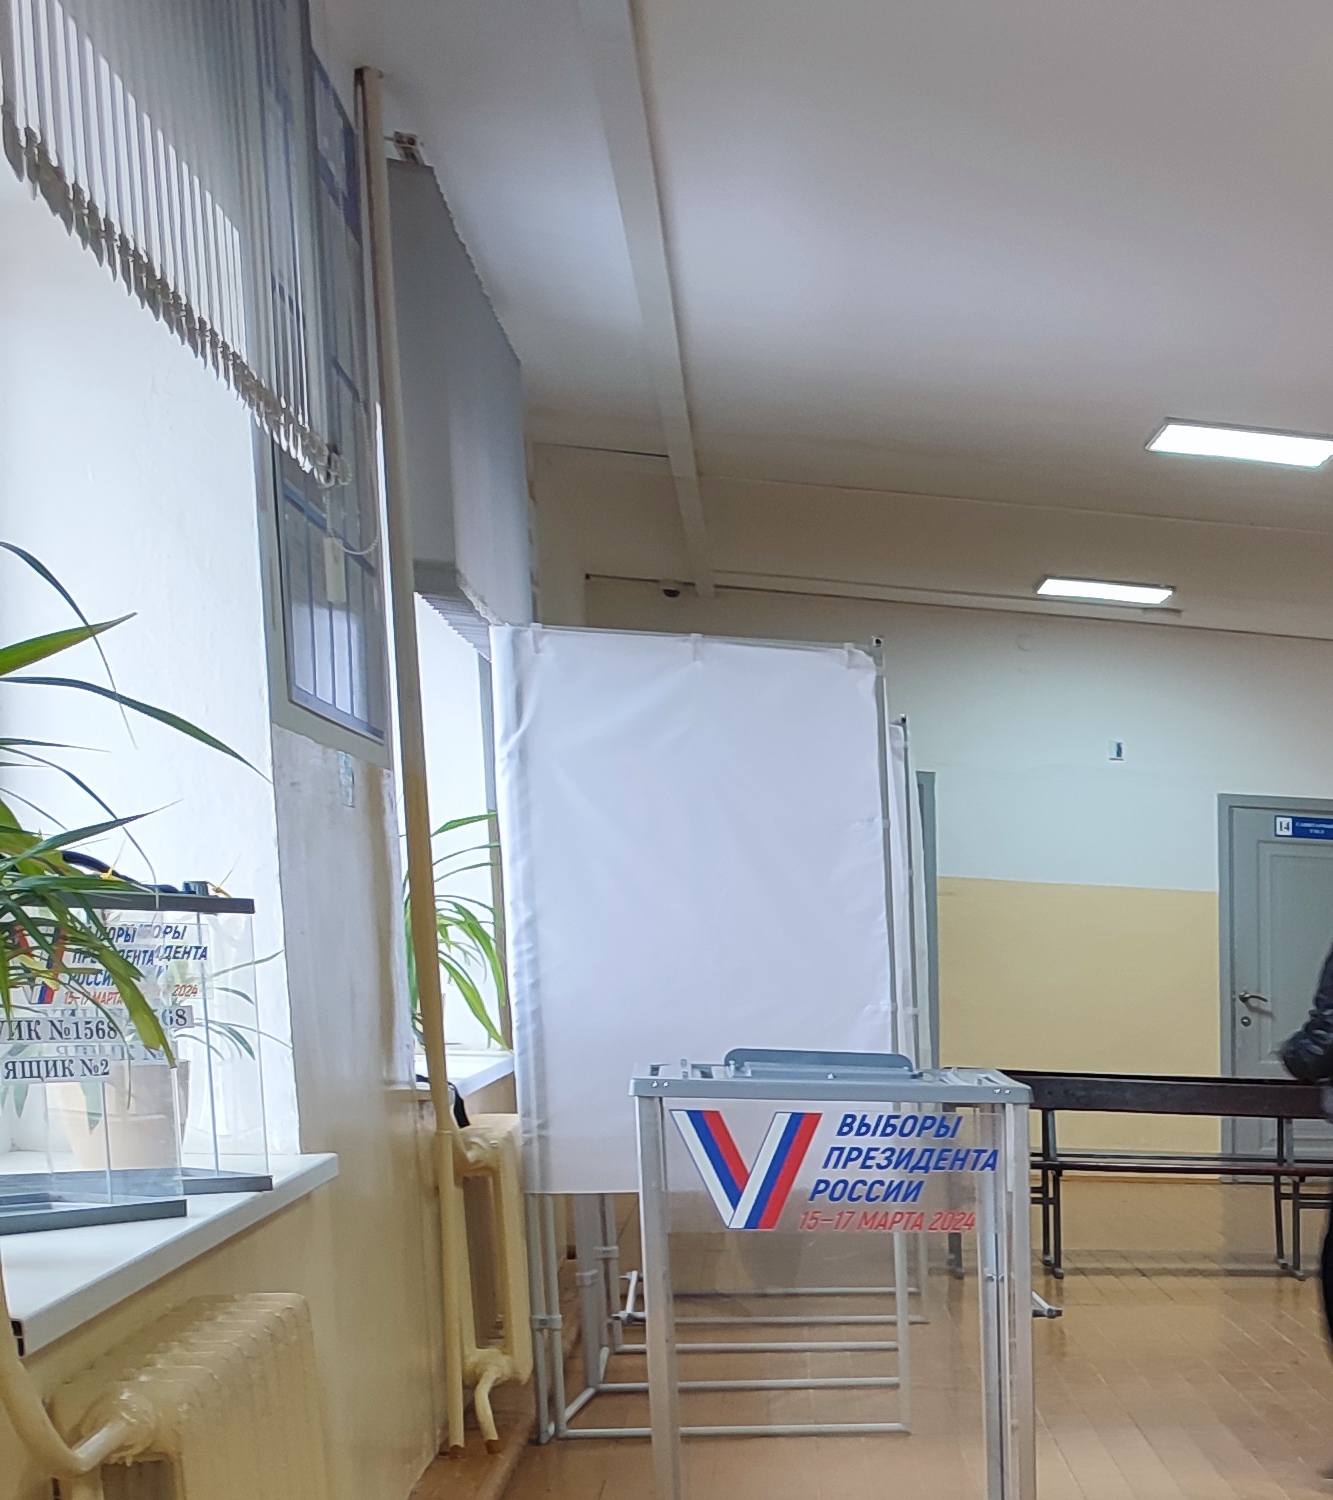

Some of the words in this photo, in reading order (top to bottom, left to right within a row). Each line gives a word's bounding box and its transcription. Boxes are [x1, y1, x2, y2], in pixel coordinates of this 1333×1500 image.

[4, 1059, 75, 1081] ЯЩИК
[835, 1113, 963, 1139] ВЫБОРЫ
[822, 1146, 999, 1174] ПРЕЗИДЕНТА
[808, 1178, 925, 1203] РОССИИ
[856, 1211, 925, 1231] МАРТА
[927, 1211, 976, 1232] 2024
